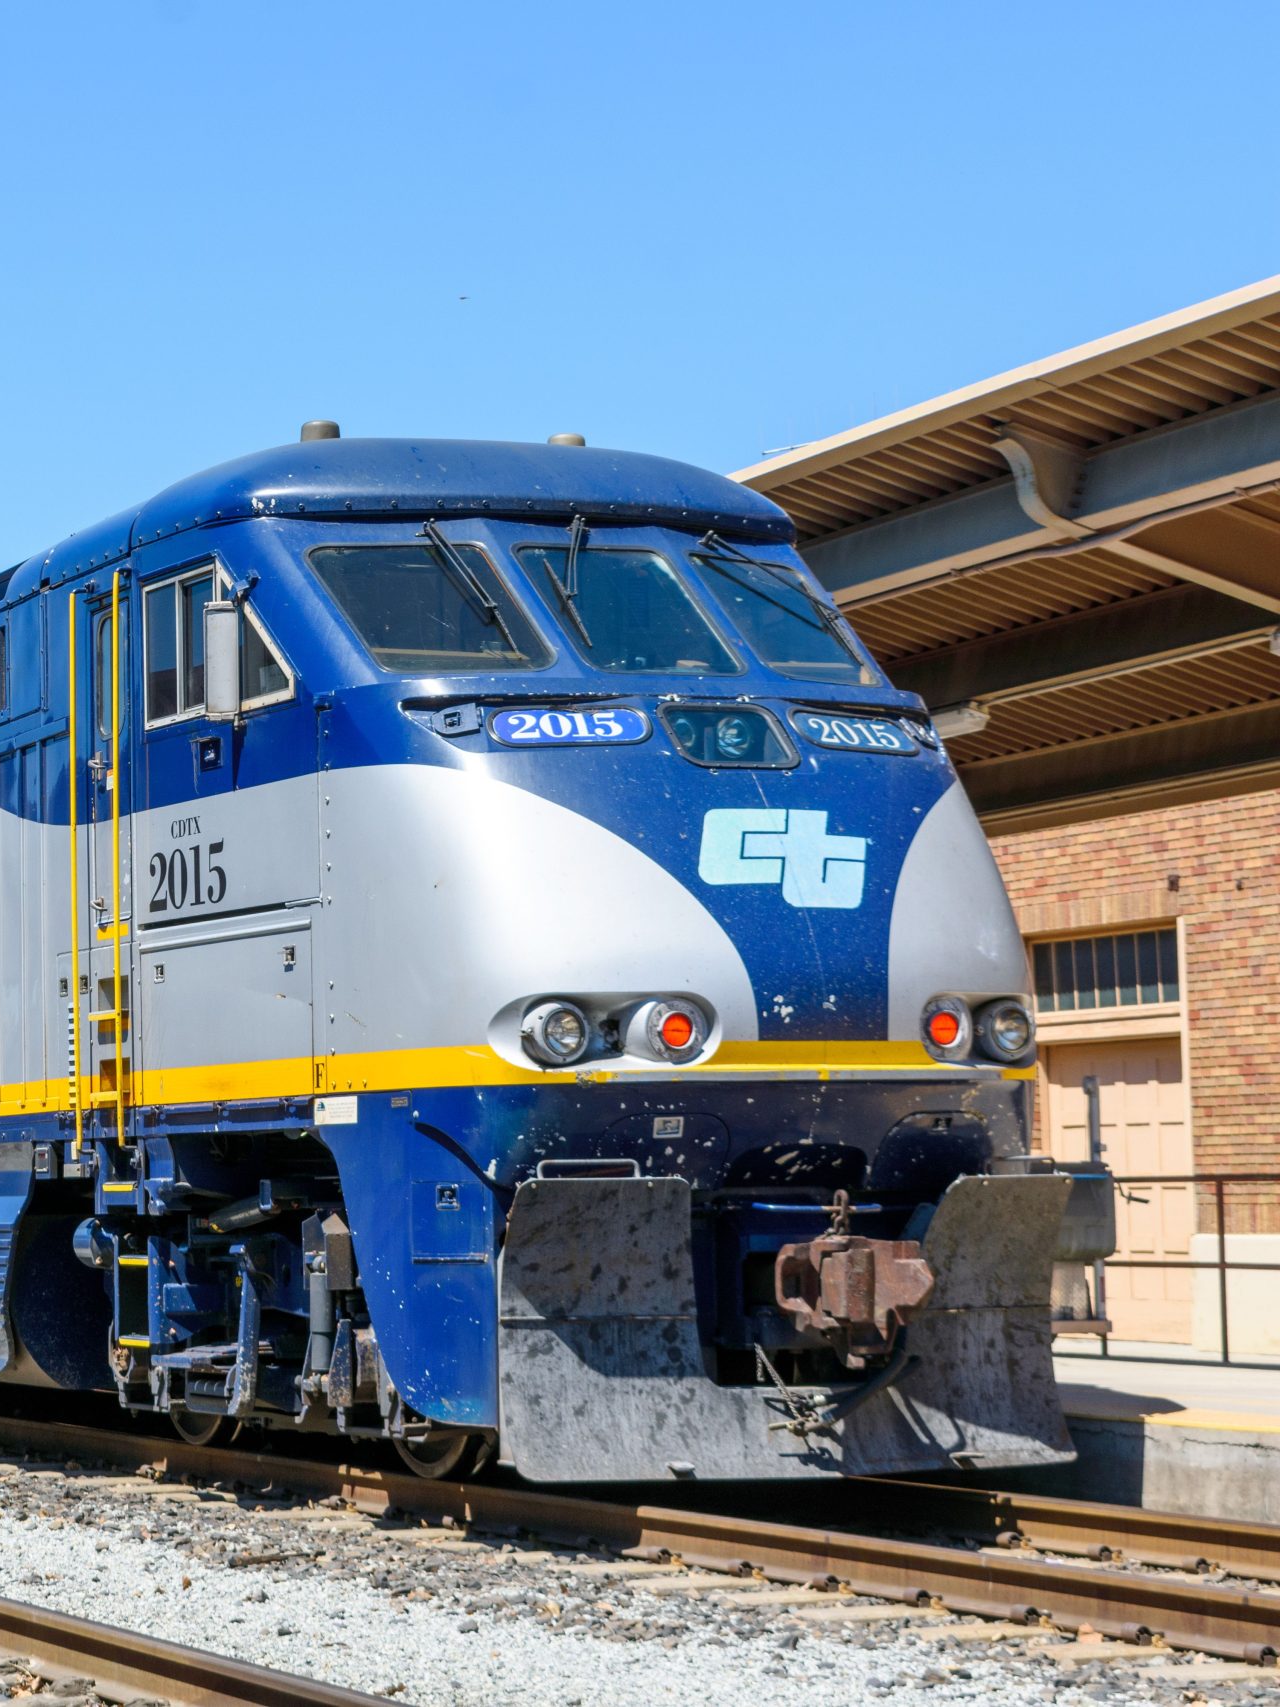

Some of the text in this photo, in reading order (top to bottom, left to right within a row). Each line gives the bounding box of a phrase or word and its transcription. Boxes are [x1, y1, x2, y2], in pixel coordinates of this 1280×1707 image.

[508, 711, 623, 740] 2015
[809, 716, 901, 750] 2015
[170, 815, 202, 839] CDTX
[149, 837, 227, 913] 2015
[315, 1062, 325, 1089] F
